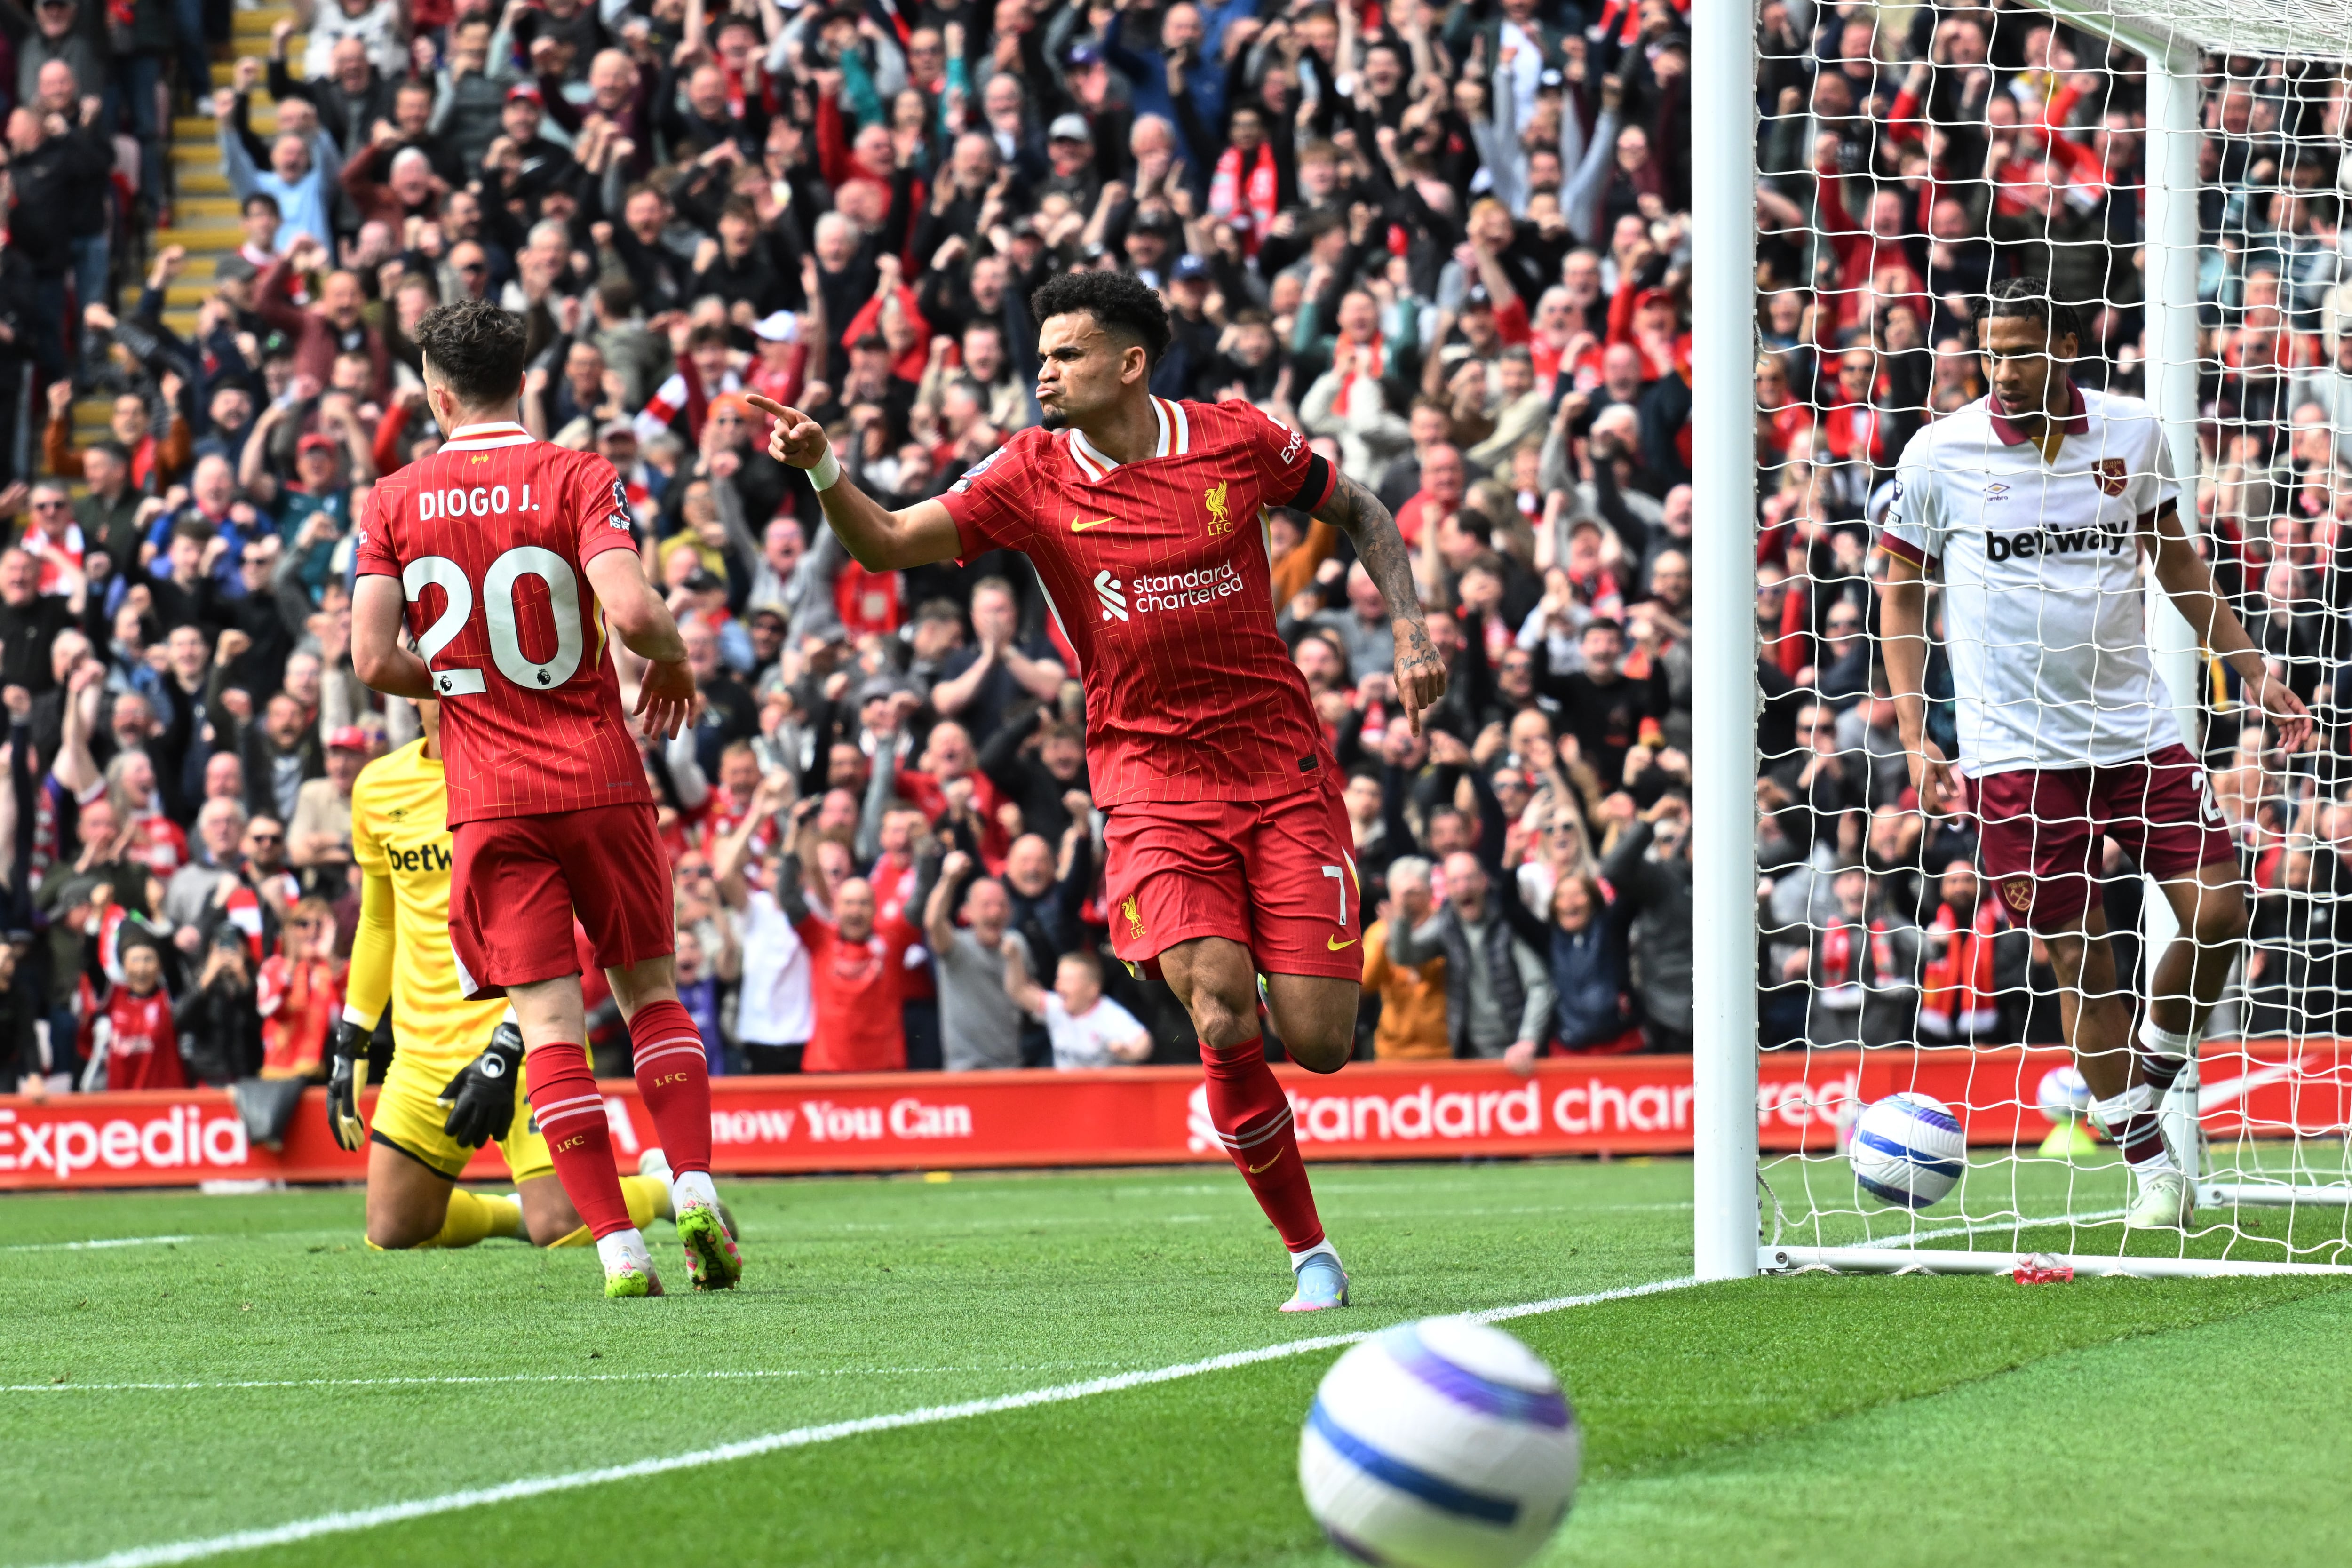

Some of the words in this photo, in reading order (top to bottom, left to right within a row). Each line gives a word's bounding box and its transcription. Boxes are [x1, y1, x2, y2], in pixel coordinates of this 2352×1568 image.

[419, 486, 509, 521] DIOGO
[518, 485, 540, 512] J.
[1986, 520, 2128, 562] betway
[1133, 559, 1236, 594] standard
[1136, 573, 1243, 613] chartered
[402, 546, 583, 696] 20
[1322, 866, 1347, 925] 7
[654, 1073, 687, 1088] LFC
[711, 1110, 795, 1144] now
[801, 1100, 884, 1142] You
[889, 1098, 973, 1139] Can
[1284, 1080, 1540, 1142] tandard
[556, 1135, 584, 1153] LFC
